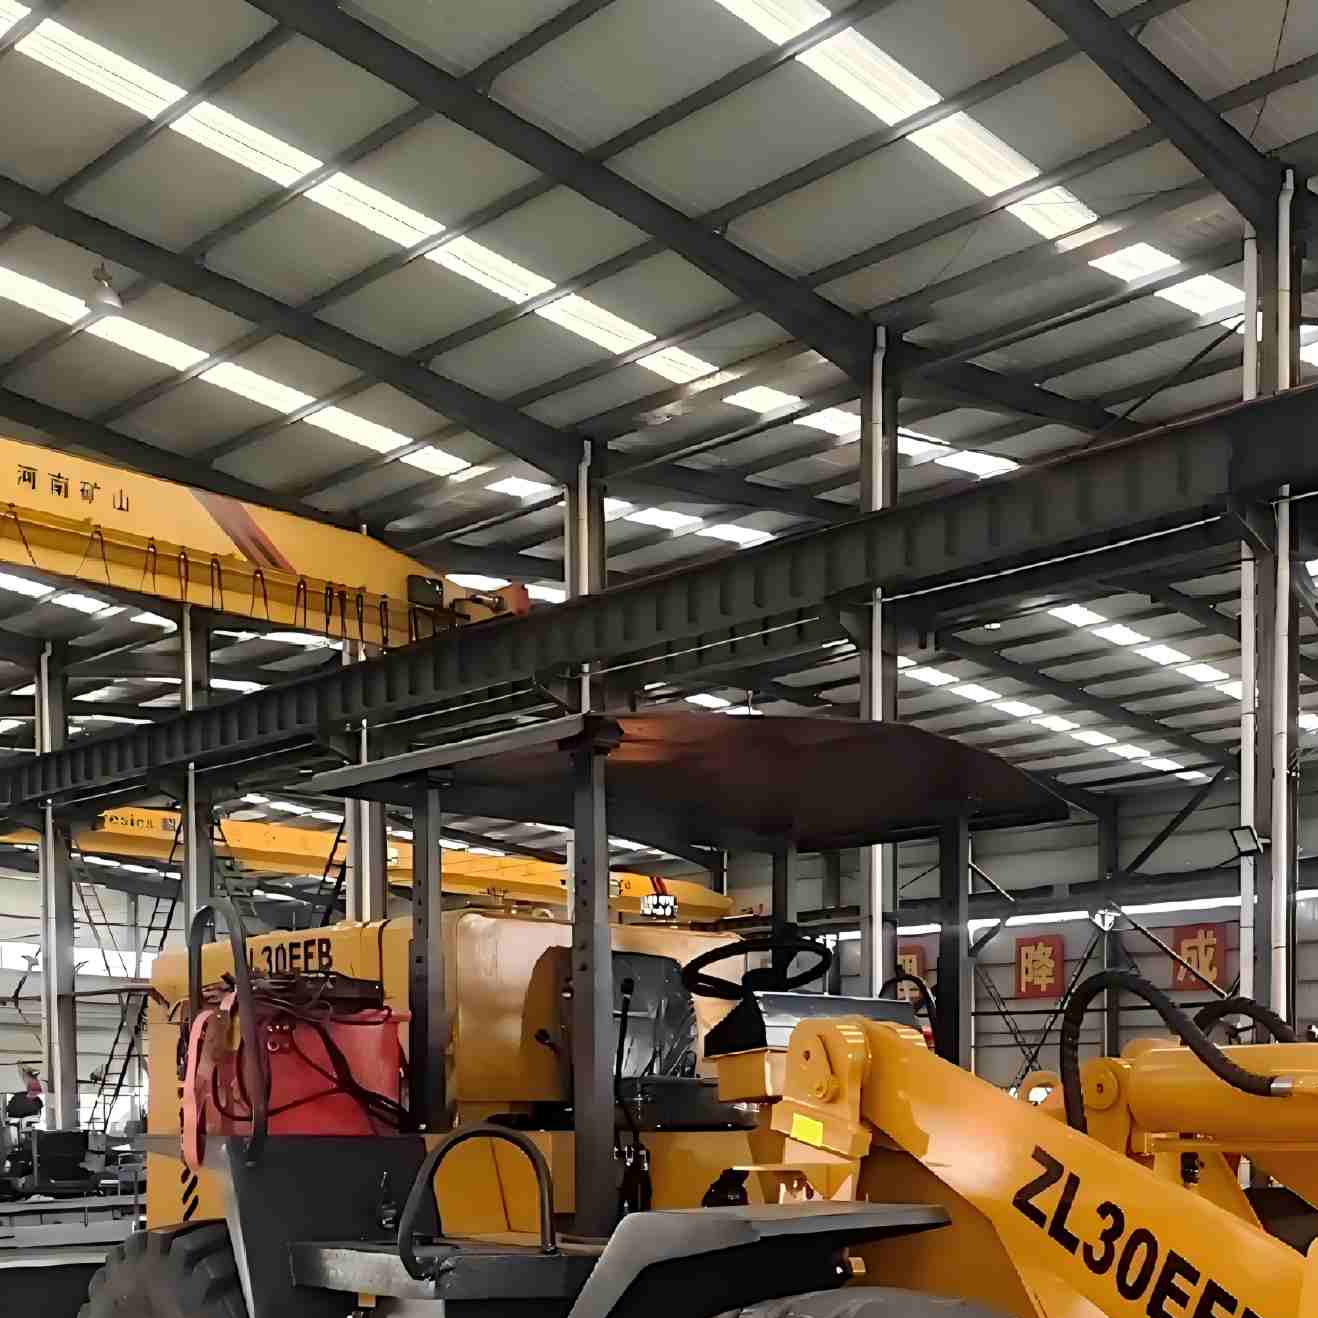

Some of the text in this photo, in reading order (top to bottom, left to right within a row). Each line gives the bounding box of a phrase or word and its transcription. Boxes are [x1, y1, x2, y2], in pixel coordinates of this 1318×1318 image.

[17, 463, 130, 512] 河南矿山
[248, 937, 333, 977] L30EFB
[1020, 942, 1056, 993] 隆
[1176, 928, 1217, 983] 成
